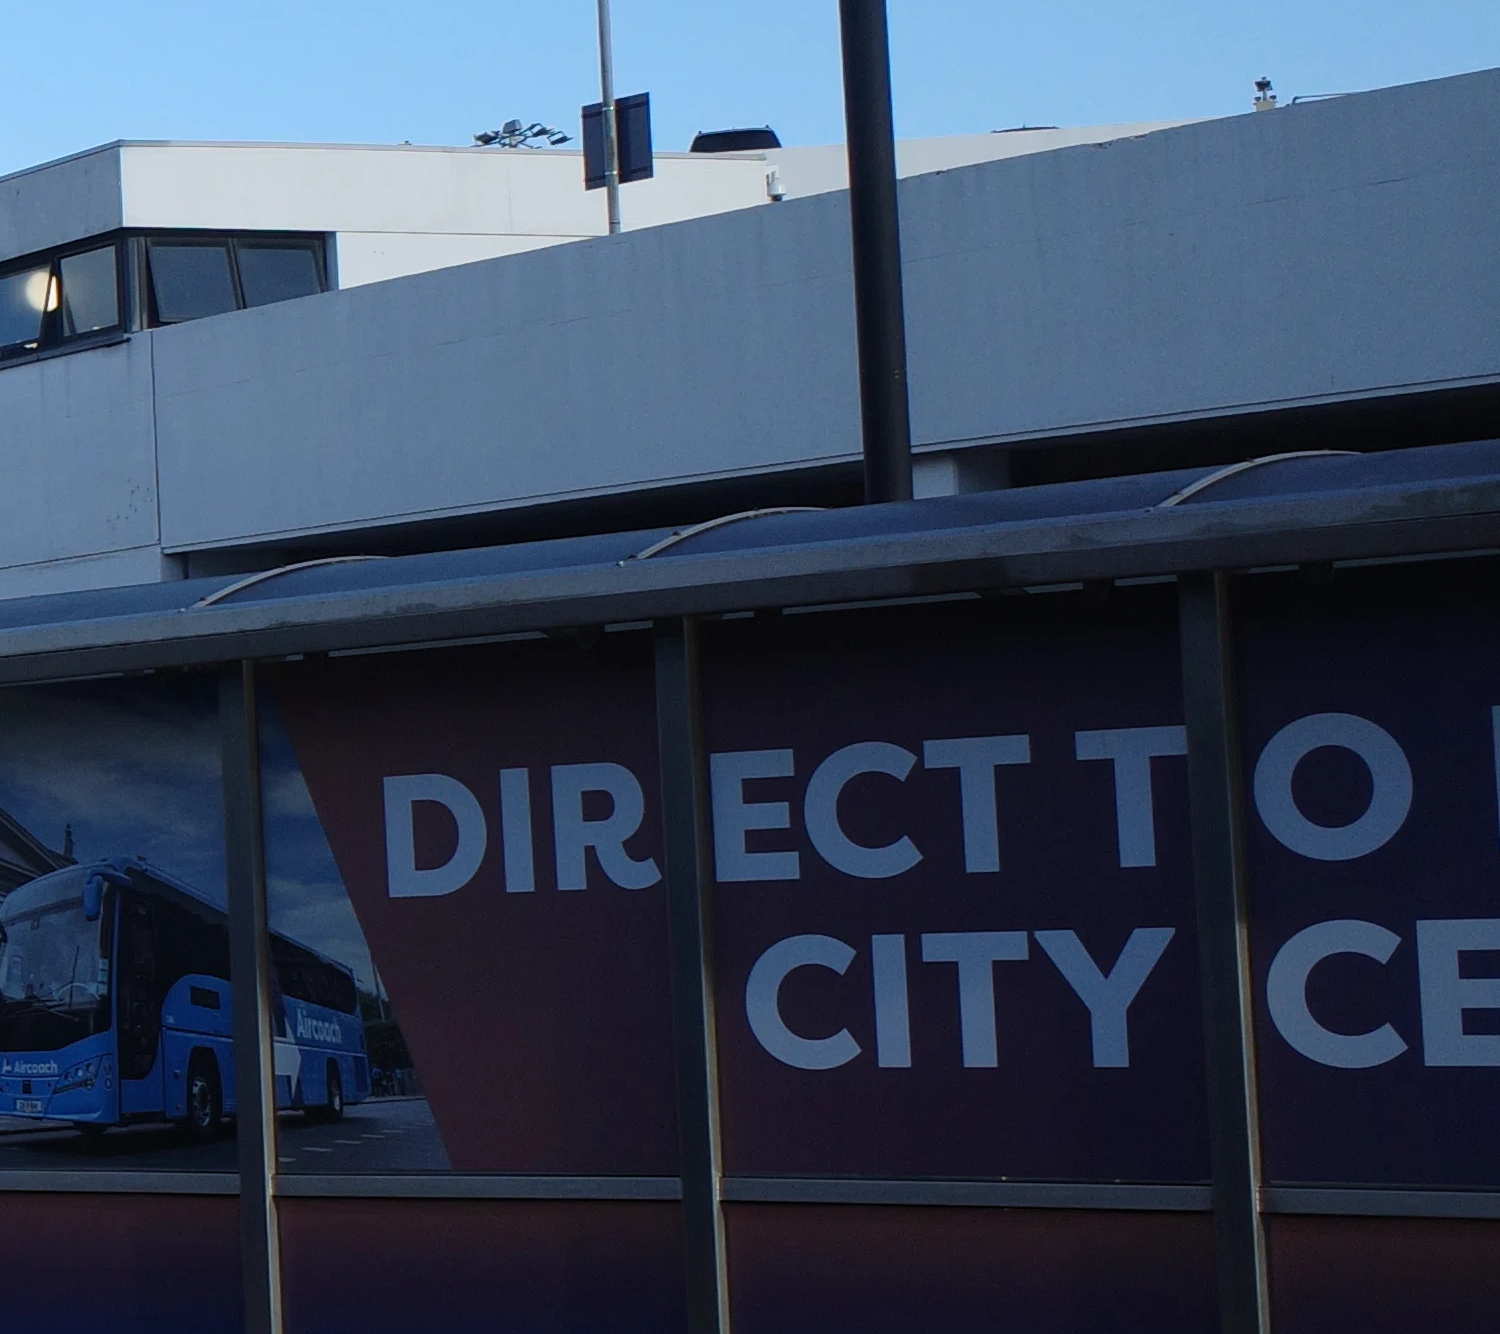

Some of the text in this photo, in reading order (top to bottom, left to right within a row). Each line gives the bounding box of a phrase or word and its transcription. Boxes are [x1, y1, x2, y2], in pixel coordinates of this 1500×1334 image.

[382, 733, 1032, 899] DIRECT
[1075, 712, 1414, 868] TO
[14, 1059, 58, 1074] Aircoach
[745, 927, 1176, 1070] CITY
